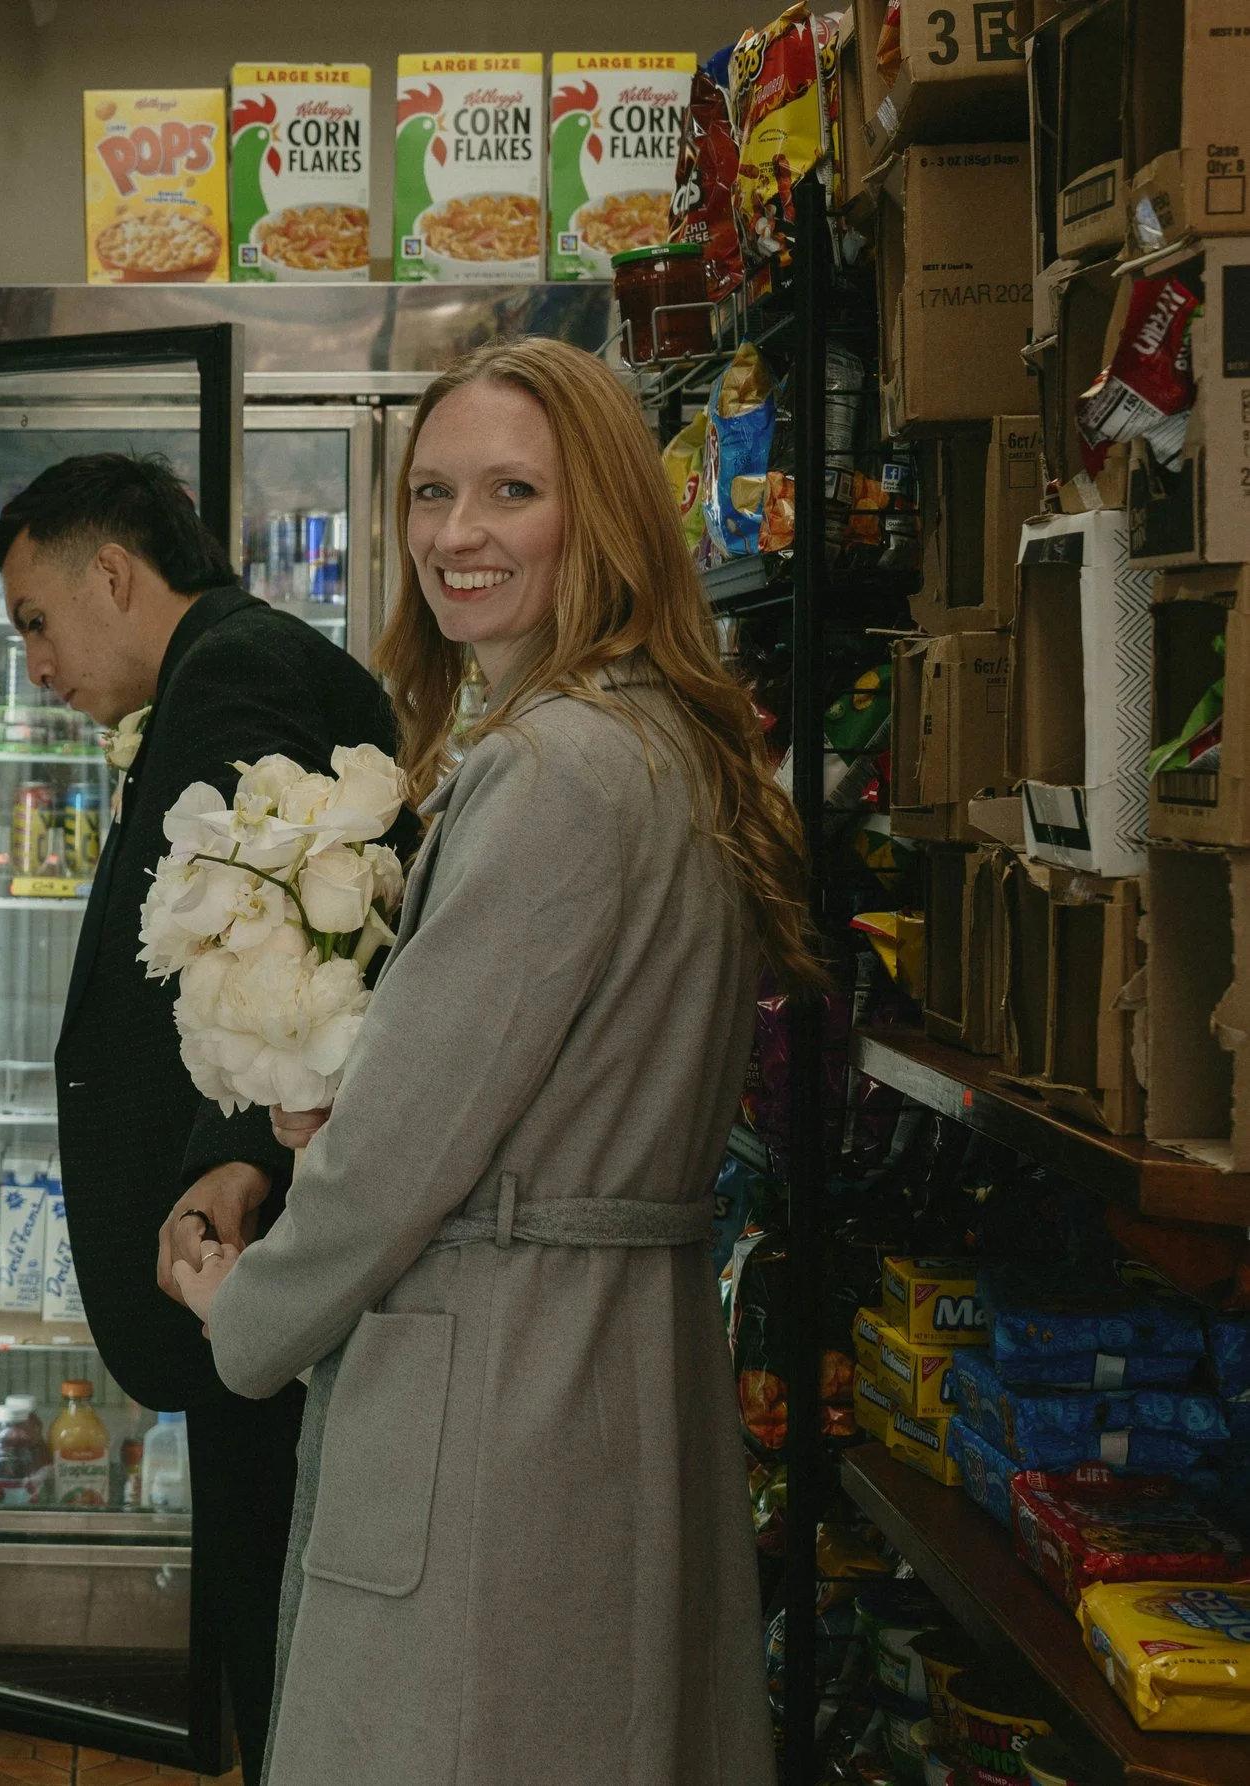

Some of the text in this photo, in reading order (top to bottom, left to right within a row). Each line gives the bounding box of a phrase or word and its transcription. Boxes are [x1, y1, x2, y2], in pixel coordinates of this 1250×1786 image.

[927, 9, 959, 65] 3
[422, 58, 521, 71] LARGE SIZE
[576, 57, 676, 69] LARGE SIZE
[256, 71, 350, 82] LARGE SIZE
[453, 106, 531, 136] CORN
[609, 105, 686, 133] CORN
[288, 119, 360, 147] CORN
[453, 137, 533, 161] FLAKES
[610, 135, 681, 158] FLAKE
[98, 121, 215, 197] POPS
[288, 149, 361, 173] FLAKES
[685, 221, 708, 236] CHO
[996, 283, 1034, 303] 202
[894, 1411, 941, 1452] Mallomars
